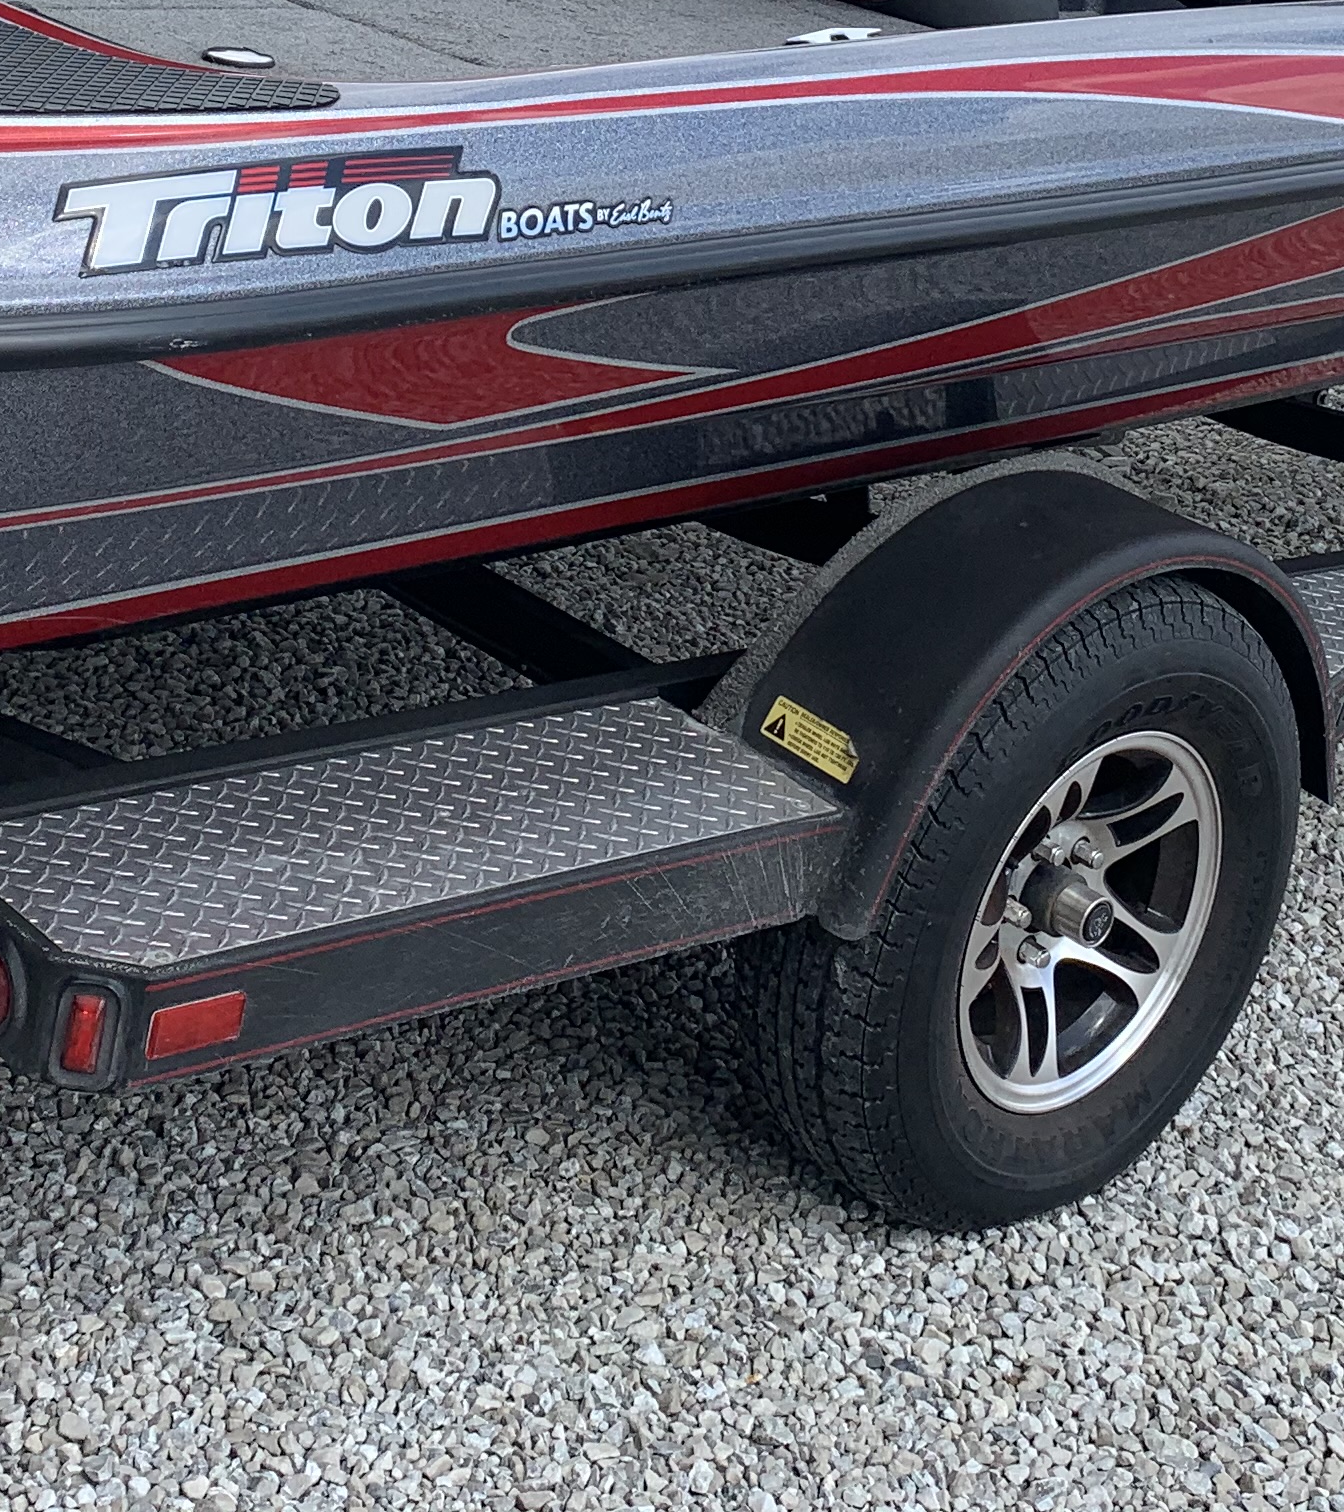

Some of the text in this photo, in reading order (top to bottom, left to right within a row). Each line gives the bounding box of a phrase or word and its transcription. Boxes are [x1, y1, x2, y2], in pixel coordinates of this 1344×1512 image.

[62, 168, 497, 269] Triton
[500, 201, 595, 239] BOATS
[596, 208, 611, 222] BY
[777, 699, 800, 716] CAUTION
